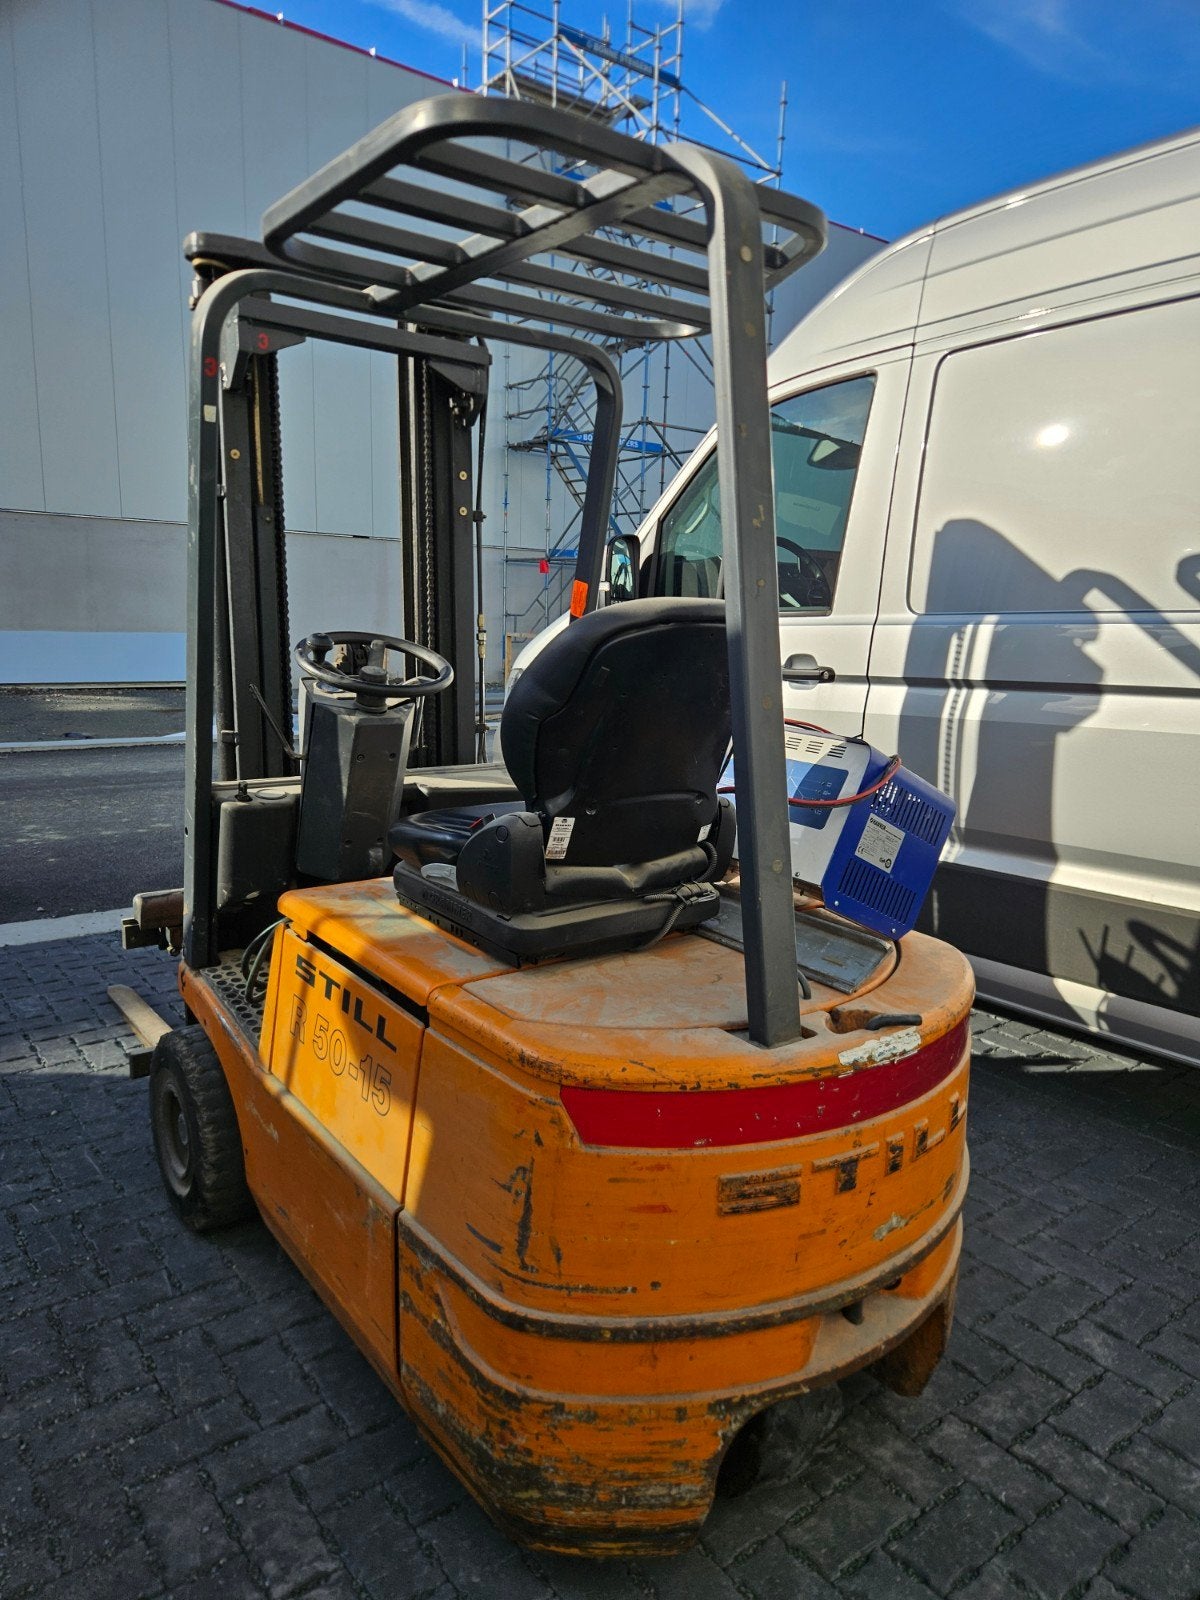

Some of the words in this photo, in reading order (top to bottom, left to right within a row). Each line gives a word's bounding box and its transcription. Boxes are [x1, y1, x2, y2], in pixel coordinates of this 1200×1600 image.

[204, 357, 218, 377] 3
[257, 332, 269, 350] 3
[295, 954, 397, 1053] STILL
[290, 993, 307, 1044] R
[313, 1014, 392, 1116] 50-15
[717, 1092, 966, 1217] STILL
